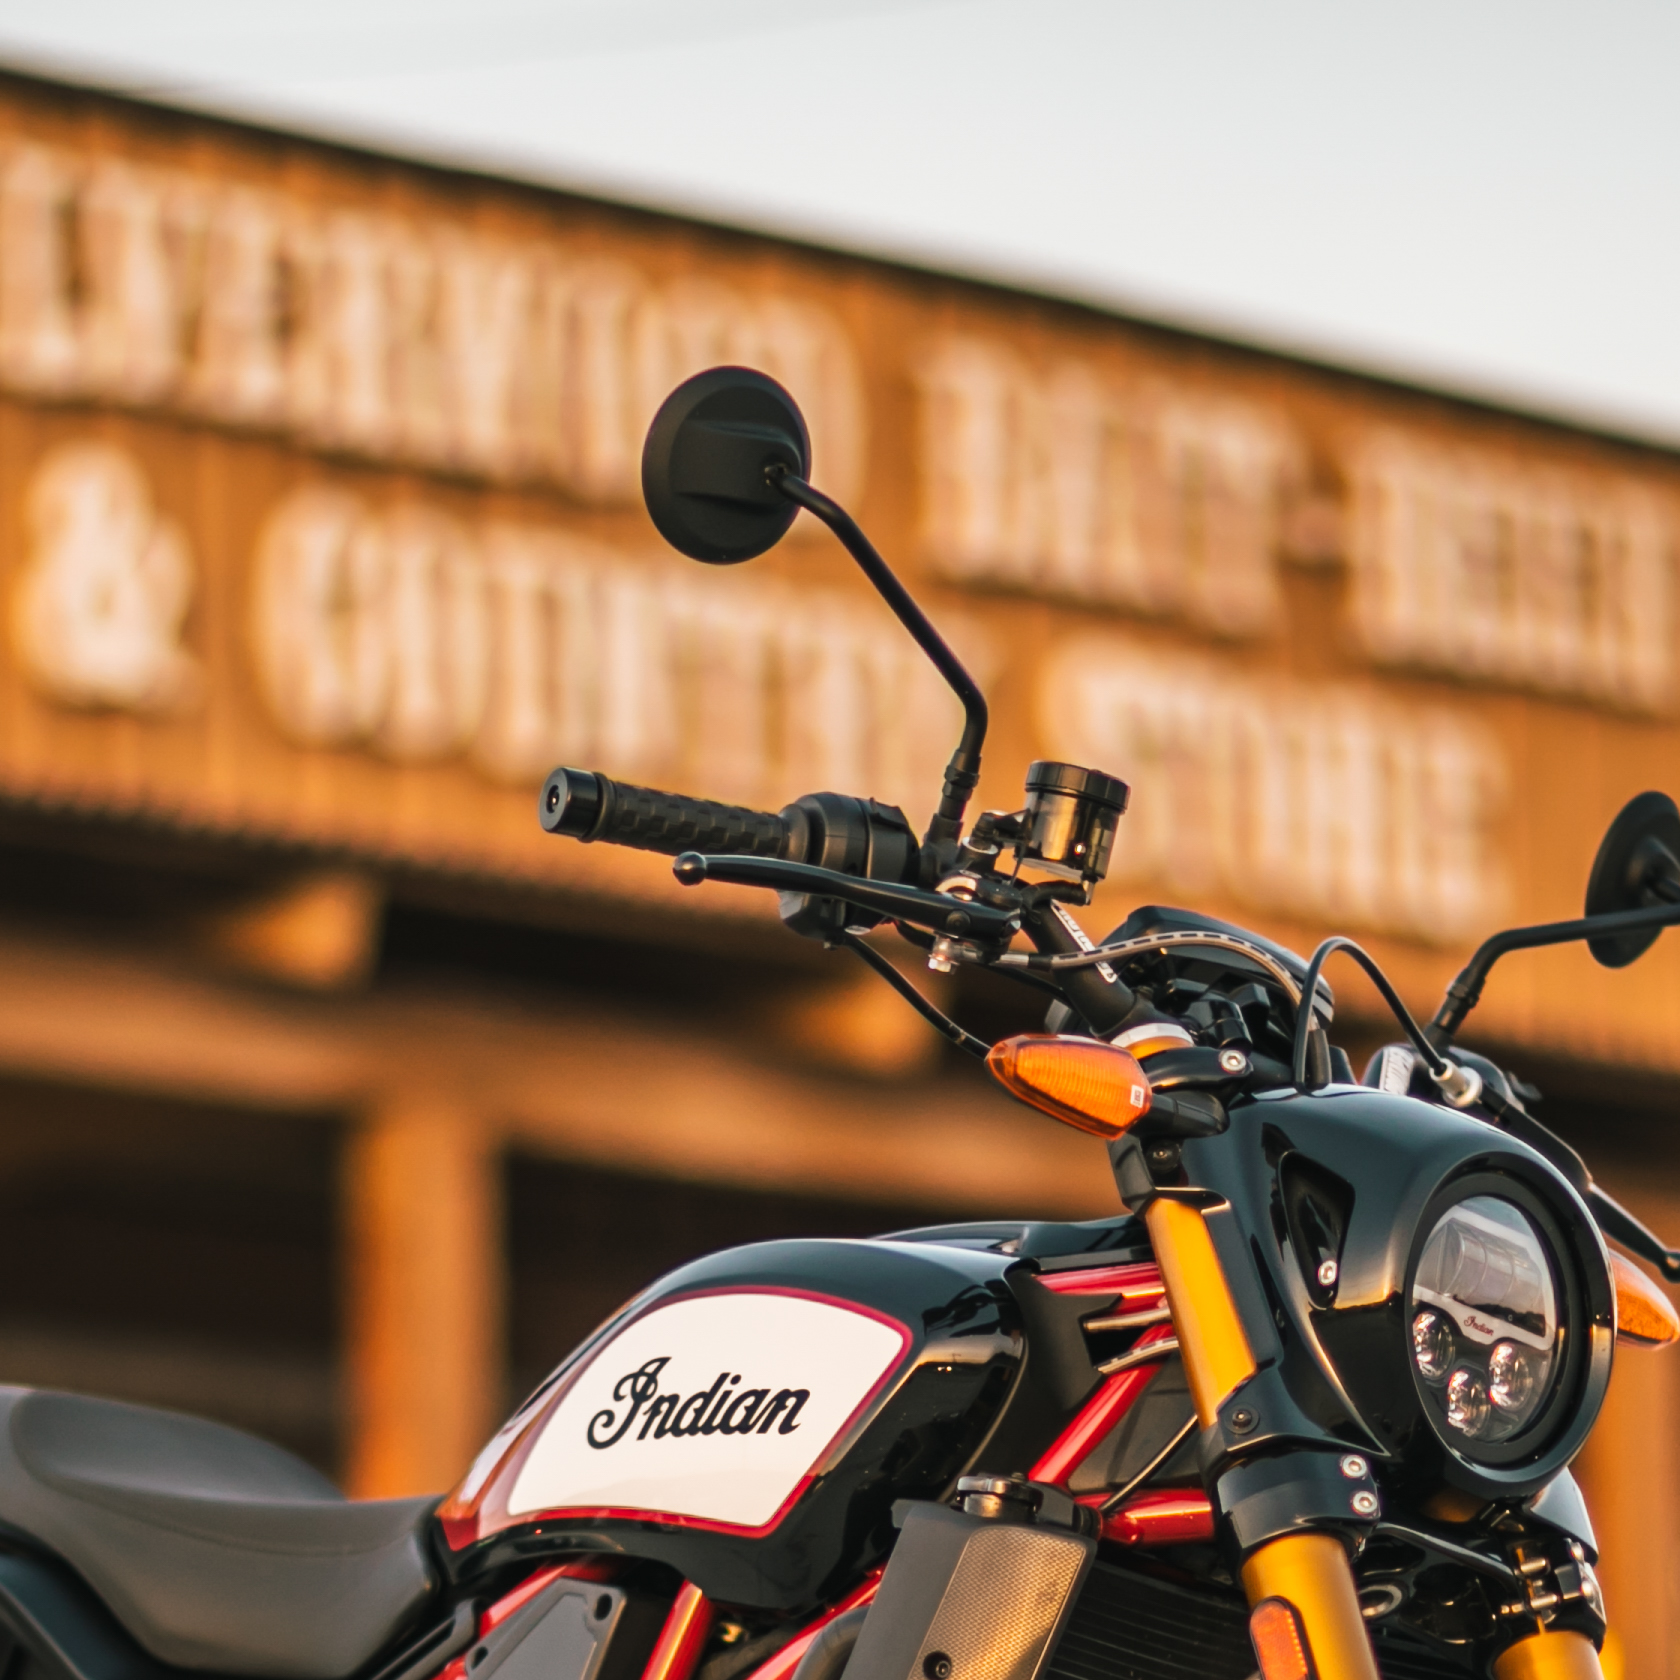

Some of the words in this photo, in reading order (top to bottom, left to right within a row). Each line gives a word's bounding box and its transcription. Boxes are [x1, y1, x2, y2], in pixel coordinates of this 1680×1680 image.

[8, 438, 206, 714] &
[1463, 1315, 1494, 1337] Indian
[587, 1356, 810, 1450] Indian
